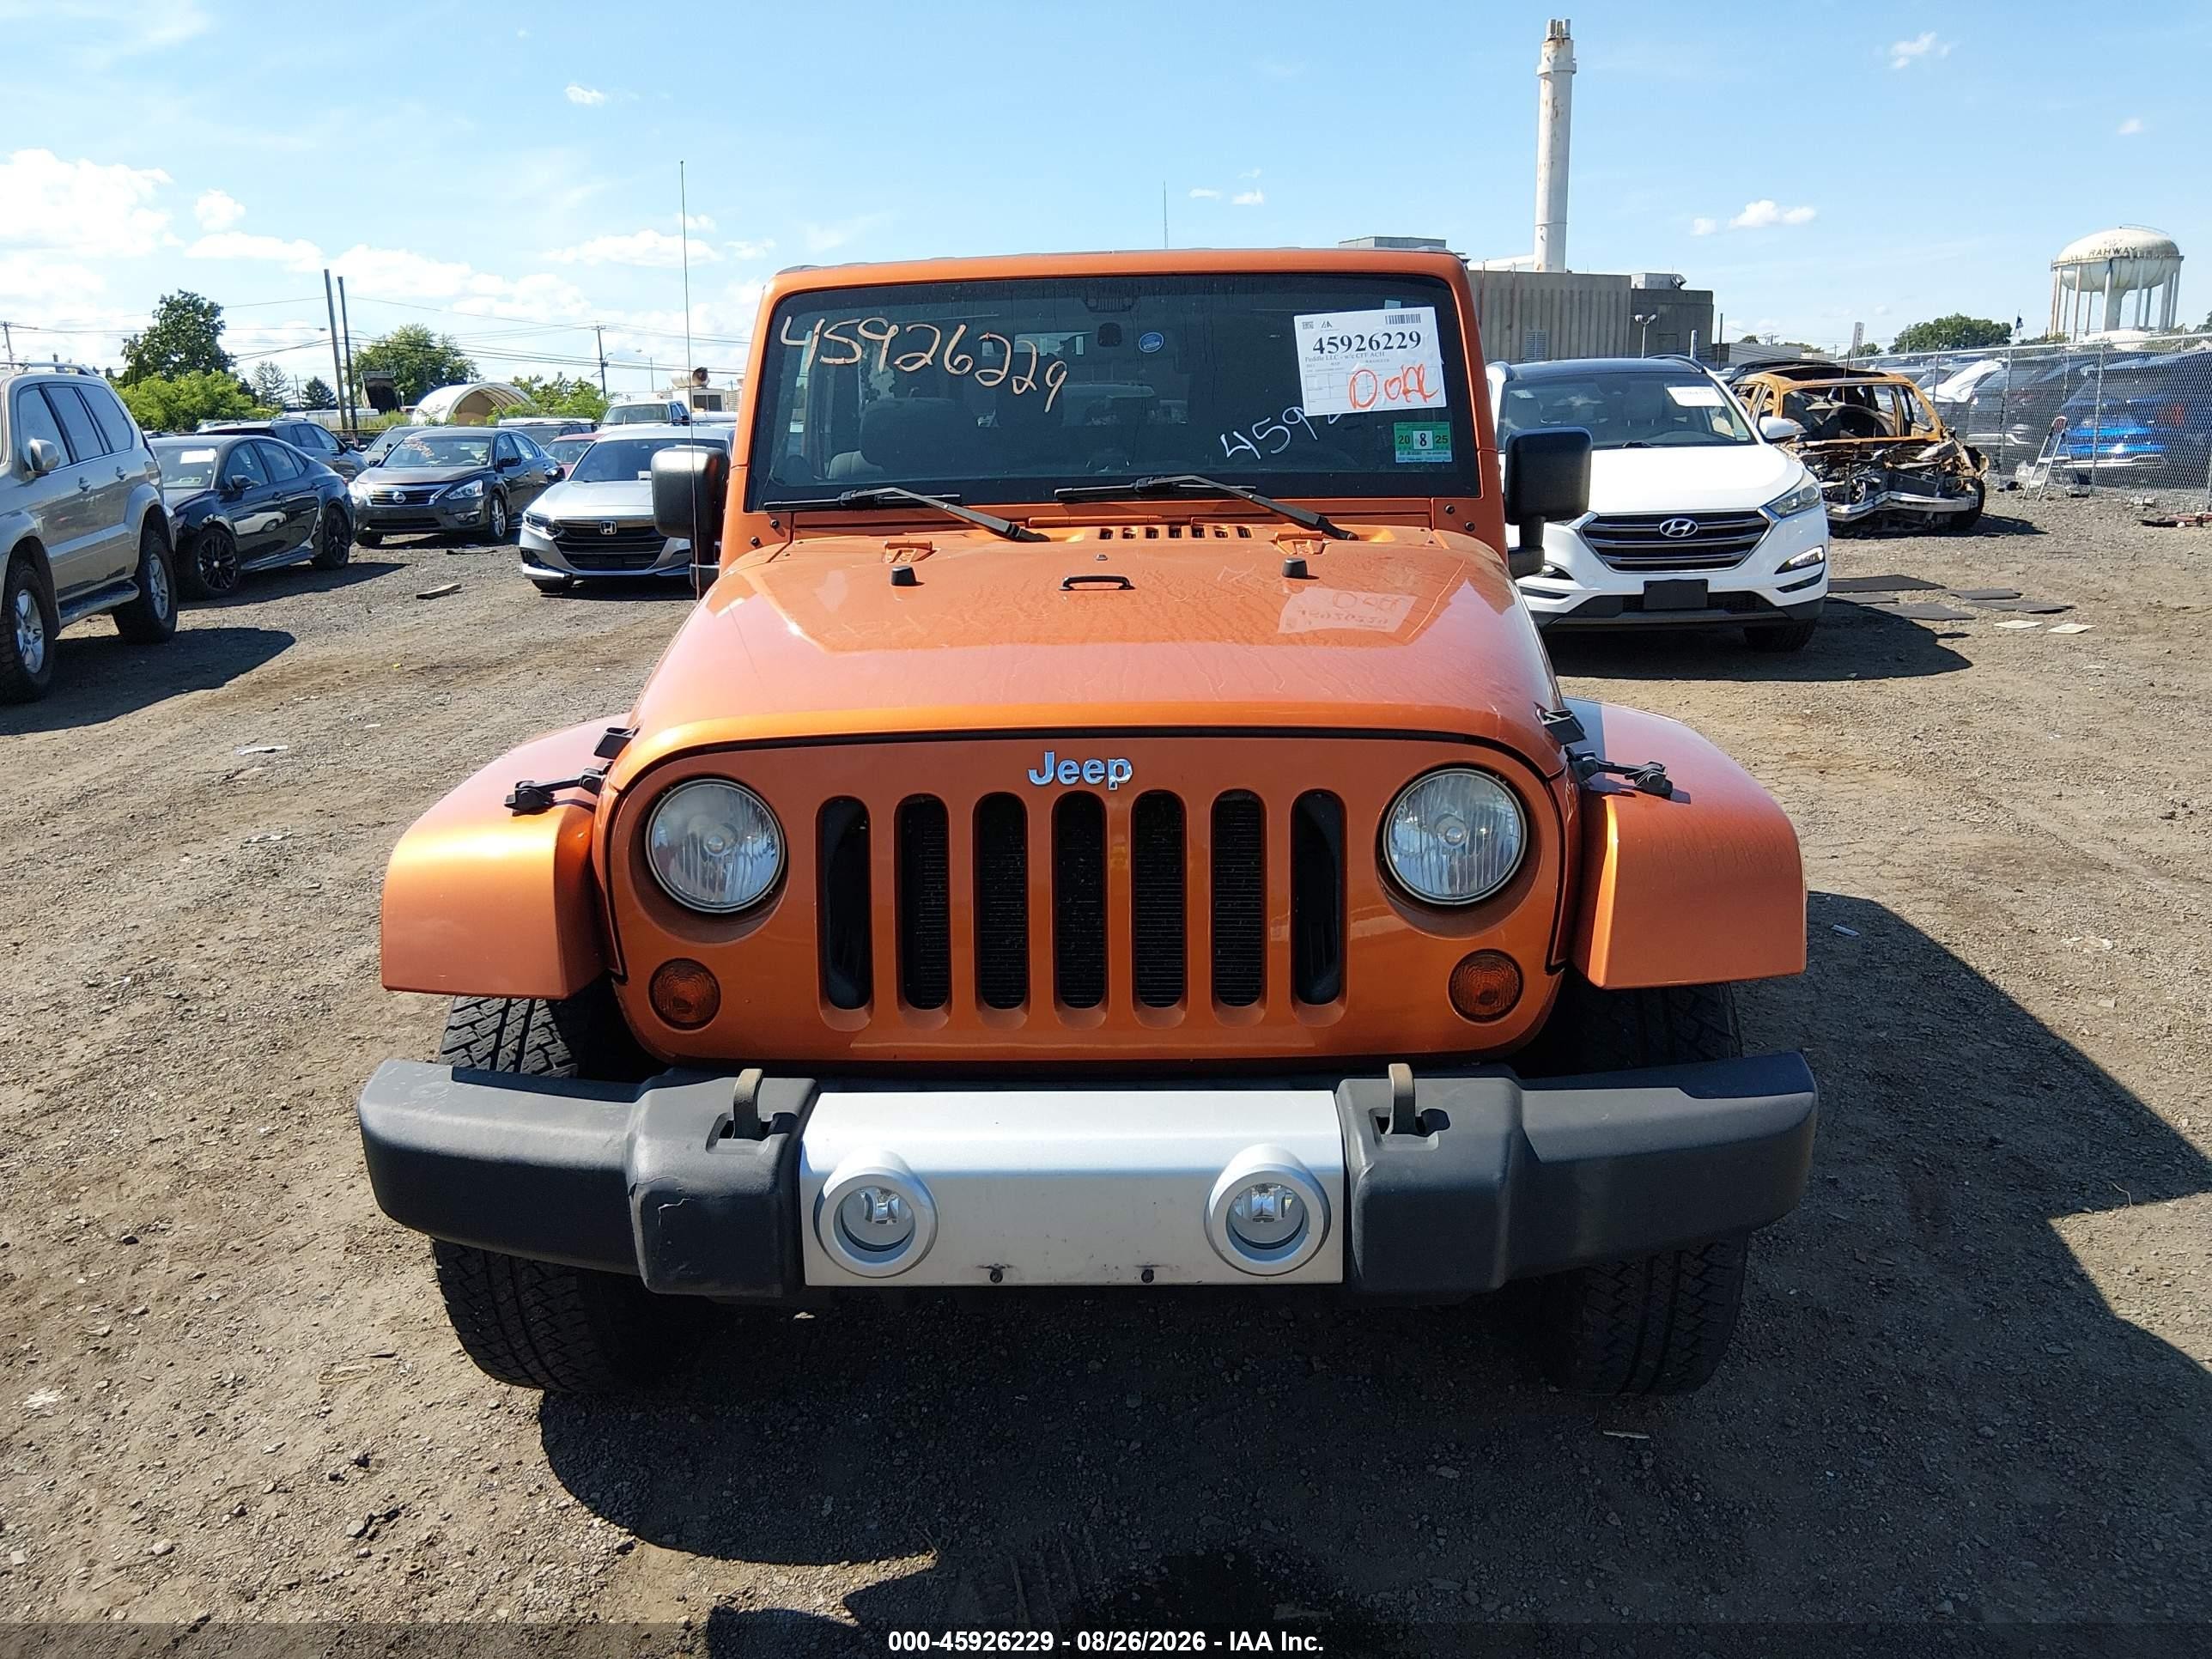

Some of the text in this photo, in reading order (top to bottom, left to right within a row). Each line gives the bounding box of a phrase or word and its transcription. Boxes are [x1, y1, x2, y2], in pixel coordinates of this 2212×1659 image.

[2088, 246, 2137, 257] RAHWAY
[1312, 331, 1421, 354] 45926229
[780, 316, 1068, 412] 45926229
[1398, 432, 1449, 447] 20 8 25
[1028, 750, 1133, 790] Jeep
